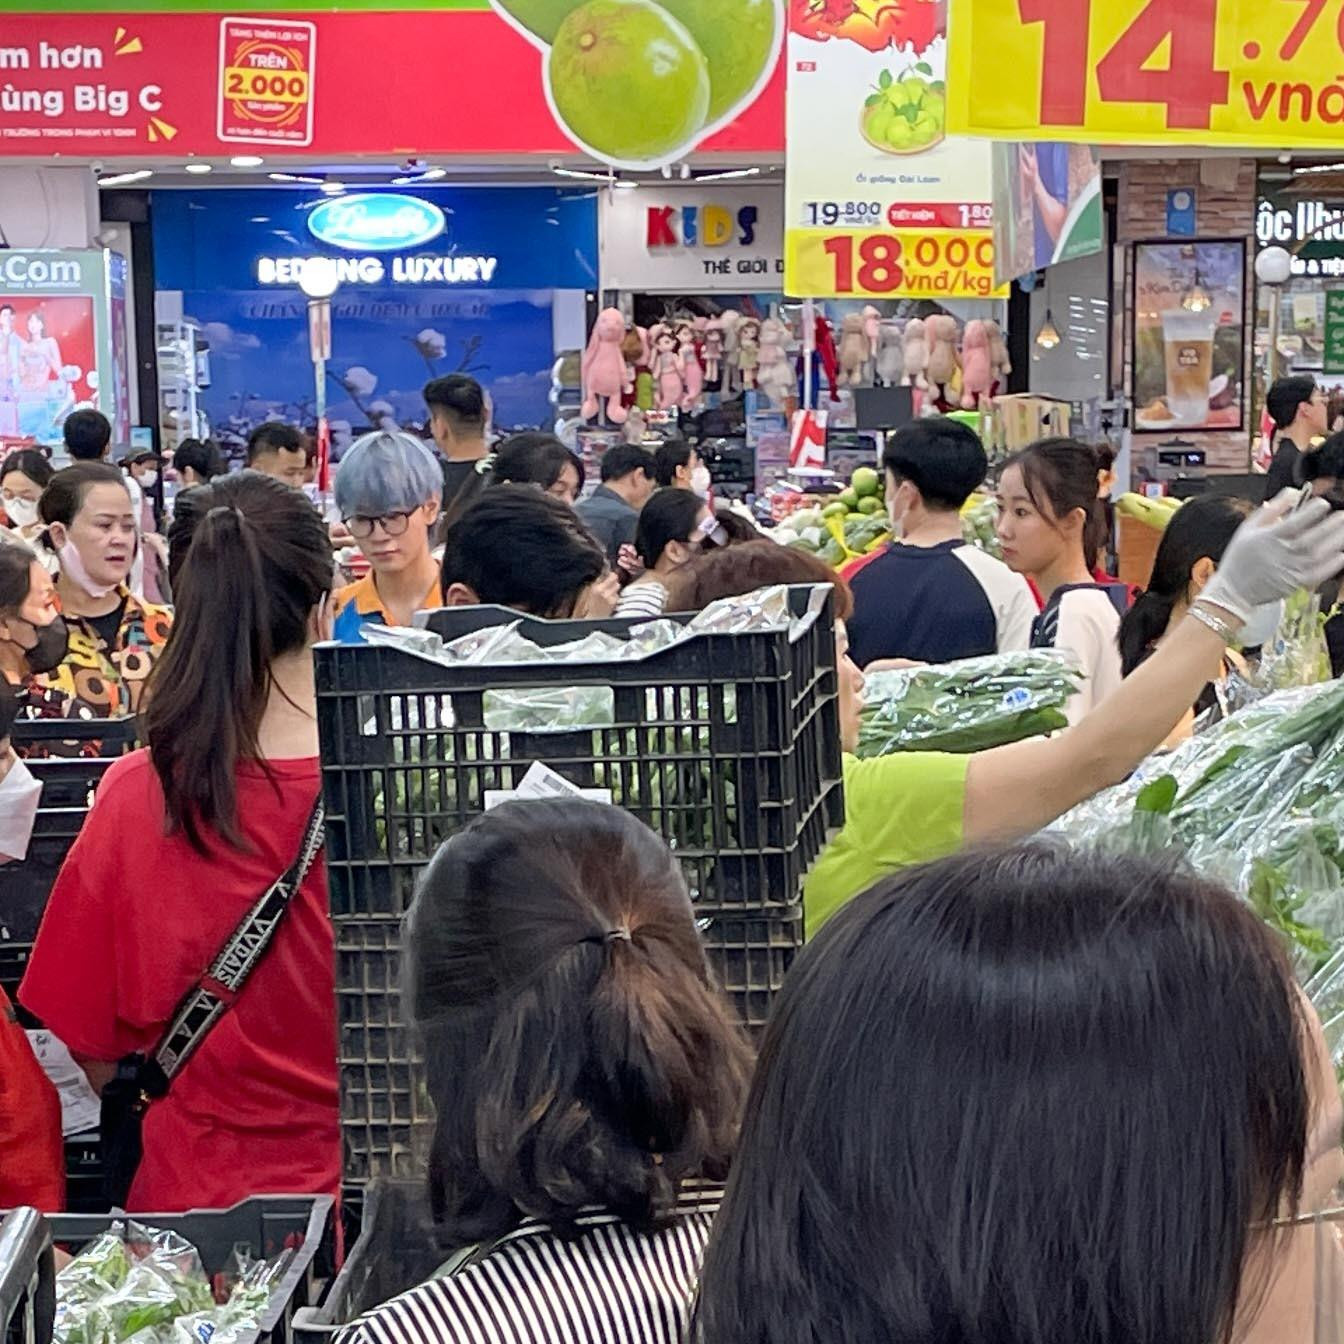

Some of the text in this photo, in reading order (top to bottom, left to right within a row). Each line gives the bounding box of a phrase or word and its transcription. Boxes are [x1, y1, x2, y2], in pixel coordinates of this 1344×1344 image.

[40, 42, 103, 68] hơn
[248, 51, 289, 69] TRÊN
[227, 73, 305, 98] 2.000
[73, 85, 129, 117] Big
[138, 85, 163, 112] C
[647, 205, 758, 246] KIDS
[957, 203, 994, 228] 1.80
[1256, 197, 1293, 246] ộc
[257, 256, 498, 283] BEDNG LUXURY
[823, 234, 994, 294] 18.000
[905, 270, 992, 295] vnđ/kg
